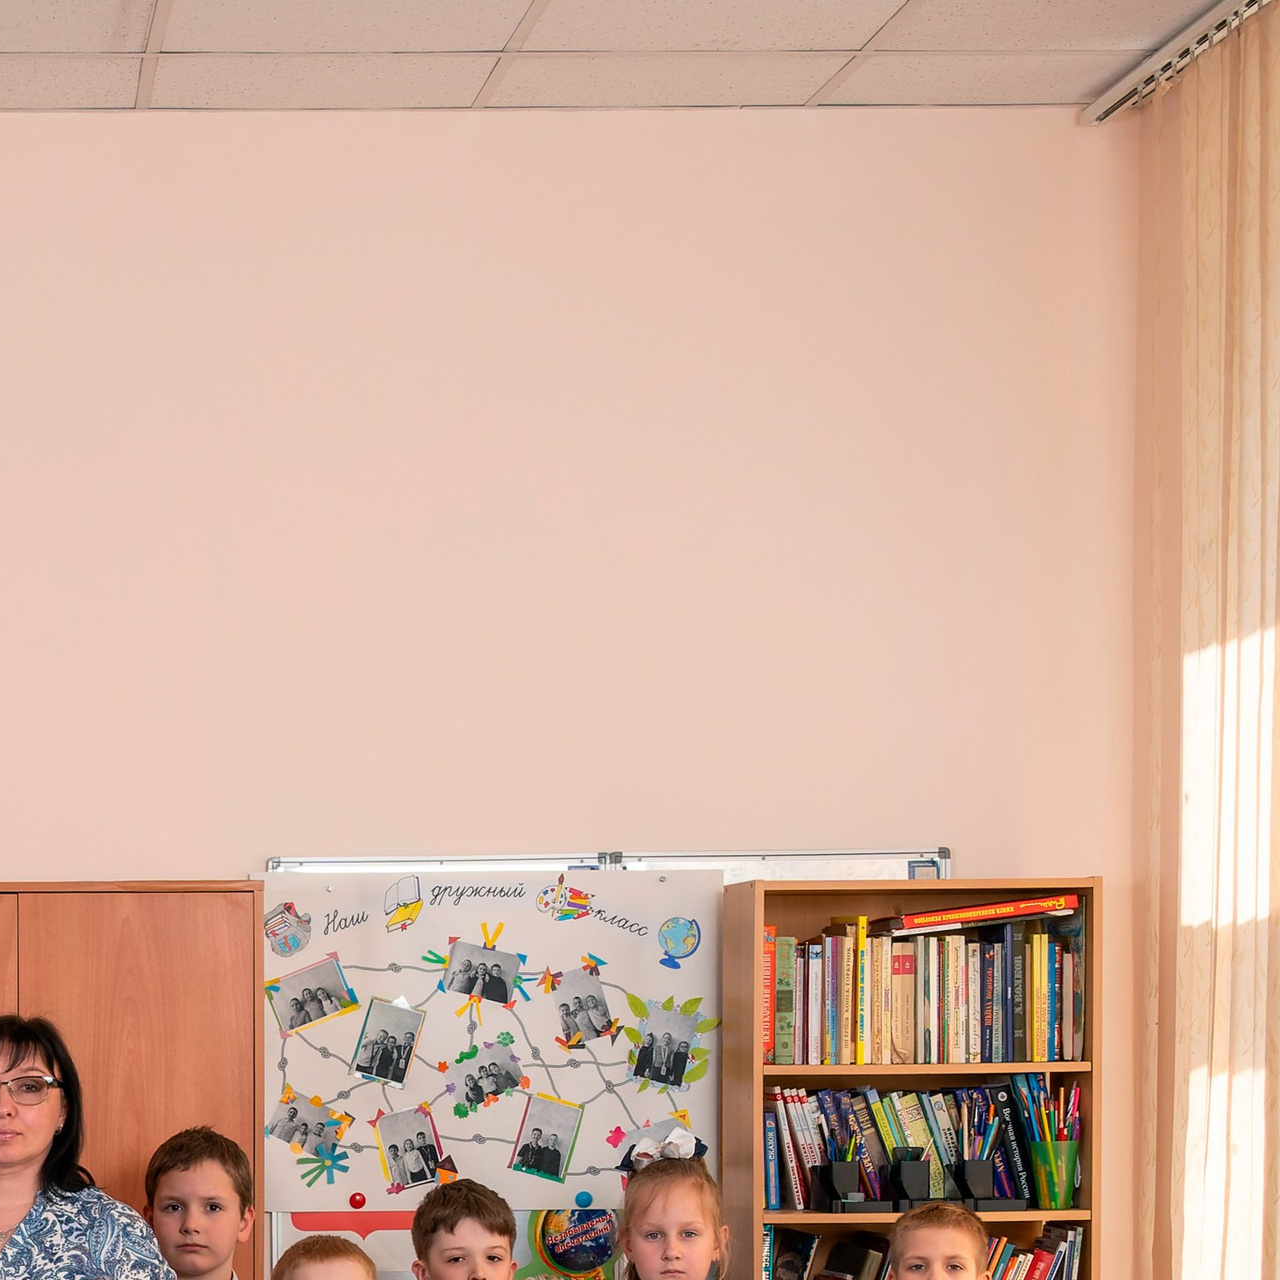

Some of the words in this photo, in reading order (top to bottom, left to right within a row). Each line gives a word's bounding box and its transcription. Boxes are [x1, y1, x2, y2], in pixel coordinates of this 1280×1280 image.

[323, 910, 369, 935] Наш
[429, 882, 527, 906] дружный
[593, 908, 649, 937] класс
[1013, 954, 1022, 1015] А.ВОЛКОВ
[984, 1000, 992, 1026] ШКОЛА
[898, 1109, 909, 1132] ШКОЛЕ
[1010, 1140, 1023, 1171] история
[1018, 1172, 1030, 1199] России
[547, 1212, 613, 1244] Незабываемых
[554, 1223, 612, 1253] впечатлений!
